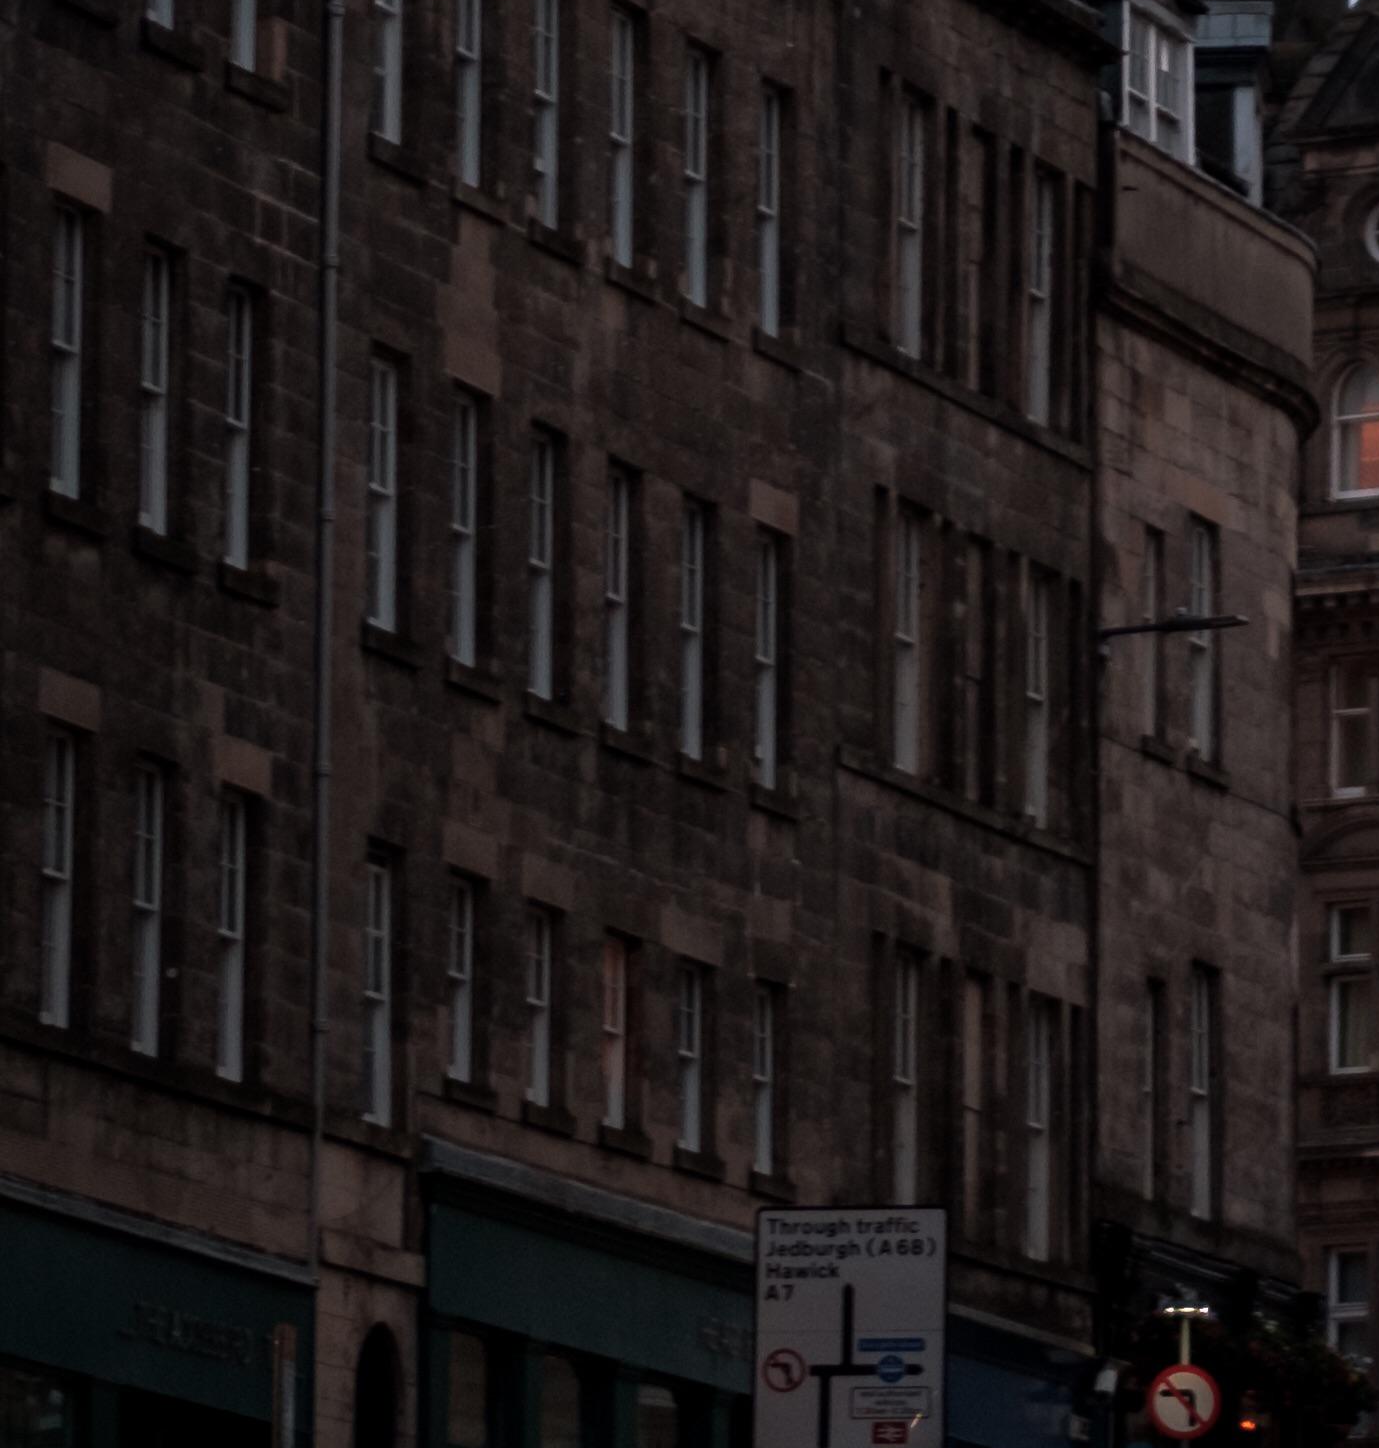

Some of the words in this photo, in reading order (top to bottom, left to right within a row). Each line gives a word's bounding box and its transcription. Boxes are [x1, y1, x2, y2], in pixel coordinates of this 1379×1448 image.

[766, 1217, 850, 1237] Through
[856, 1216, 921, 1234] traffic
[766, 1239, 861, 1259] Jedburgh
[765, 1262, 840, 1278] Hawick
[764, 1283, 795, 1301] A7
